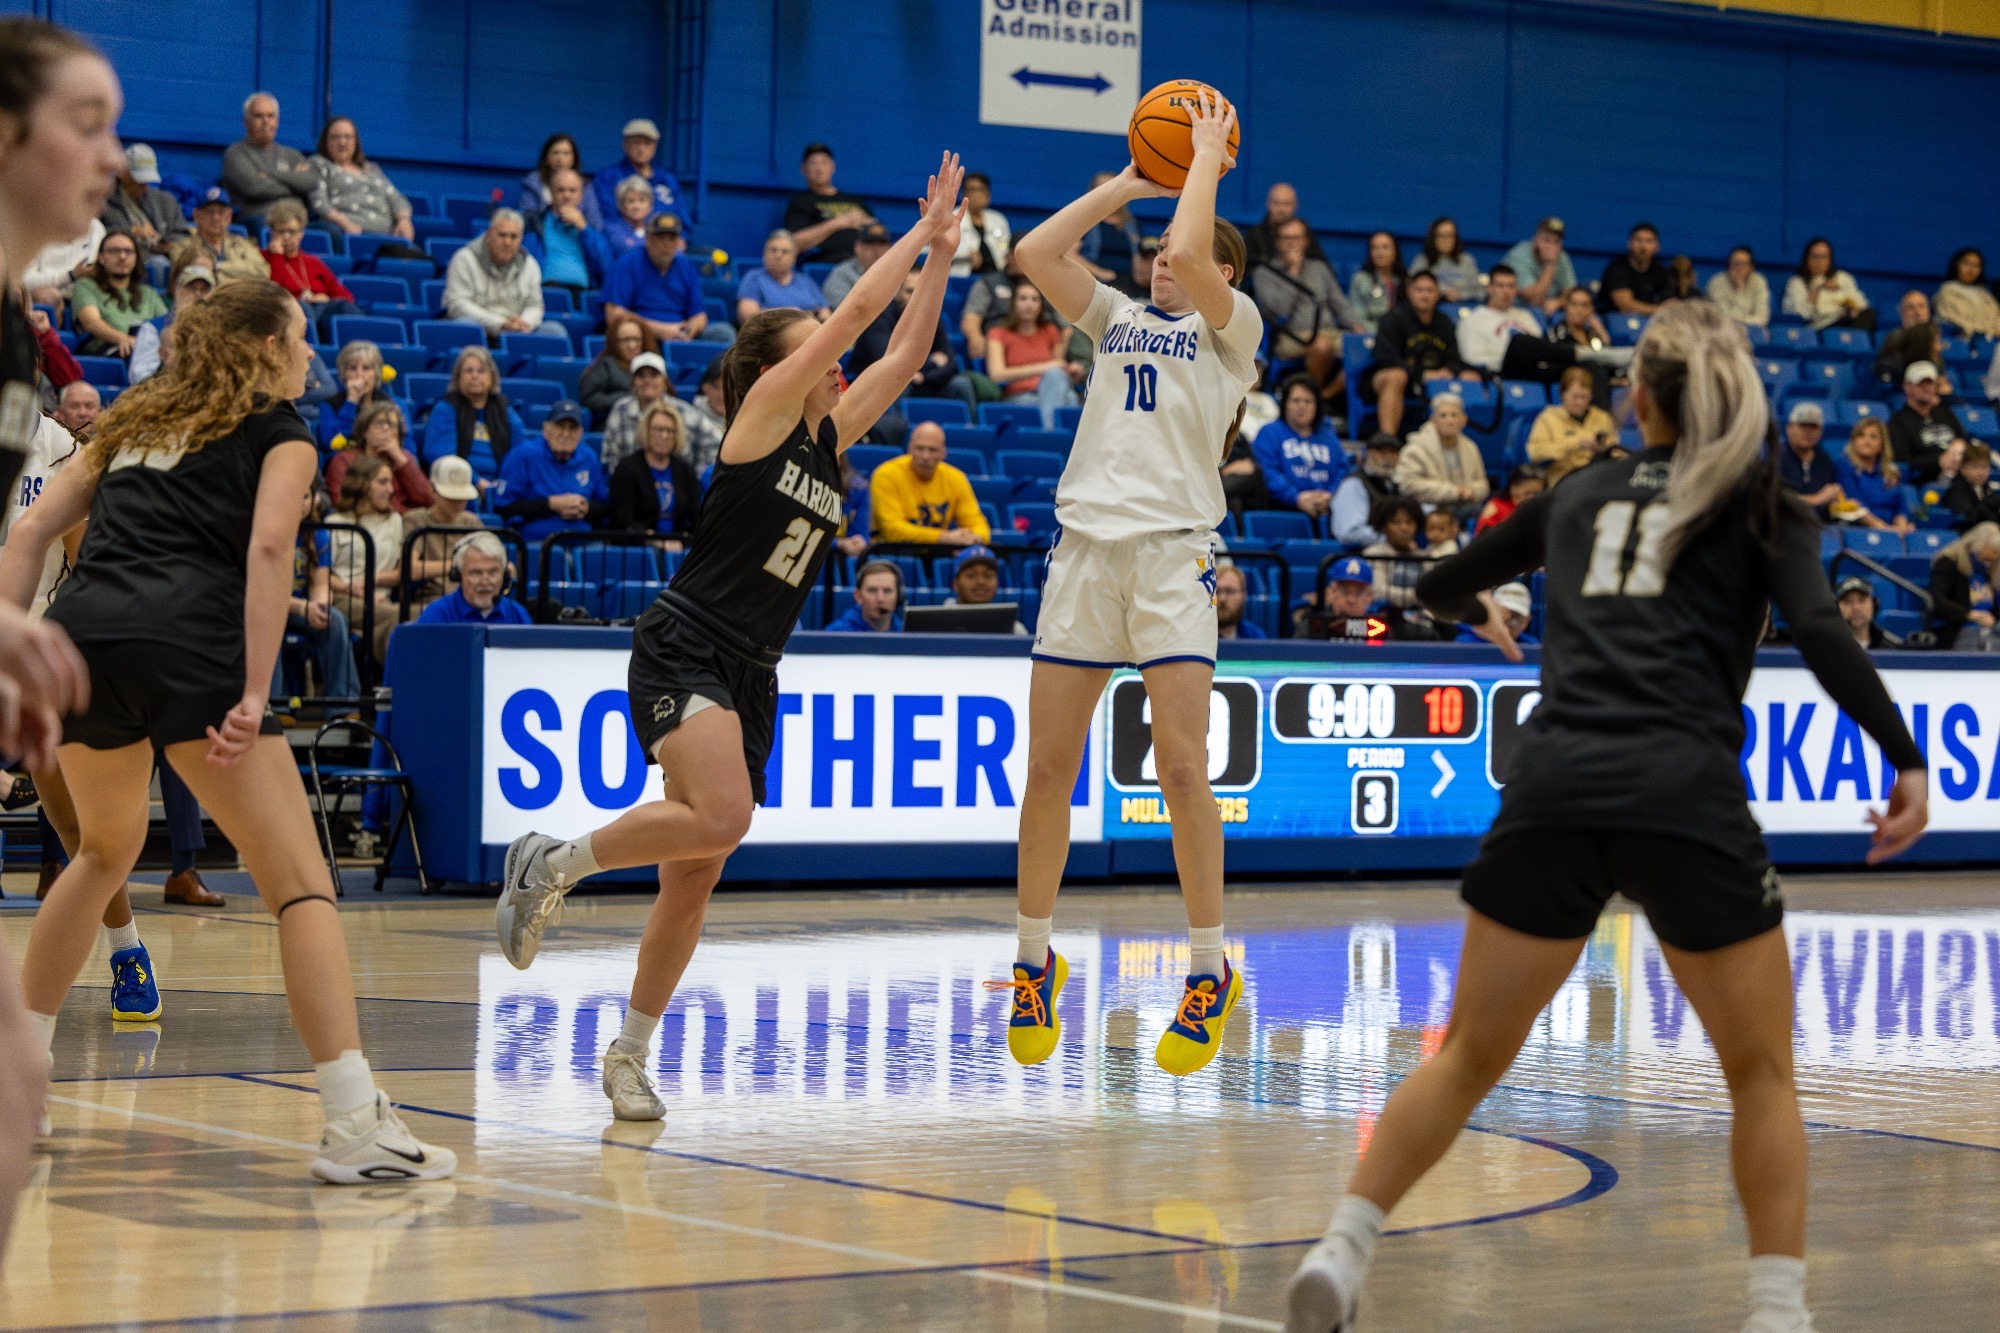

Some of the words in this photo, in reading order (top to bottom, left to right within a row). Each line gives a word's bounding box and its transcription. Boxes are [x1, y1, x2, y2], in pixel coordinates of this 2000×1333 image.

[989, 14, 1137, 47] Admission
[994, 0, 1132, 22] General
[1123, 364, 1158, 412] 10
[14, 475, 43, 507] RS
[762, 516, 826, 588] 21
[1580, 501, 1672, 597] 11
[1308, 683, 1396, 738] 9:00
[1424, 686, 1463, 734] 10
[498, 688, 1090, 810] SOTHER
[1347, 747, 1405, 768] PERIOD
[1121, 797, 1249, 823] MULRS
[1363, 780, 1387, 825] 3
